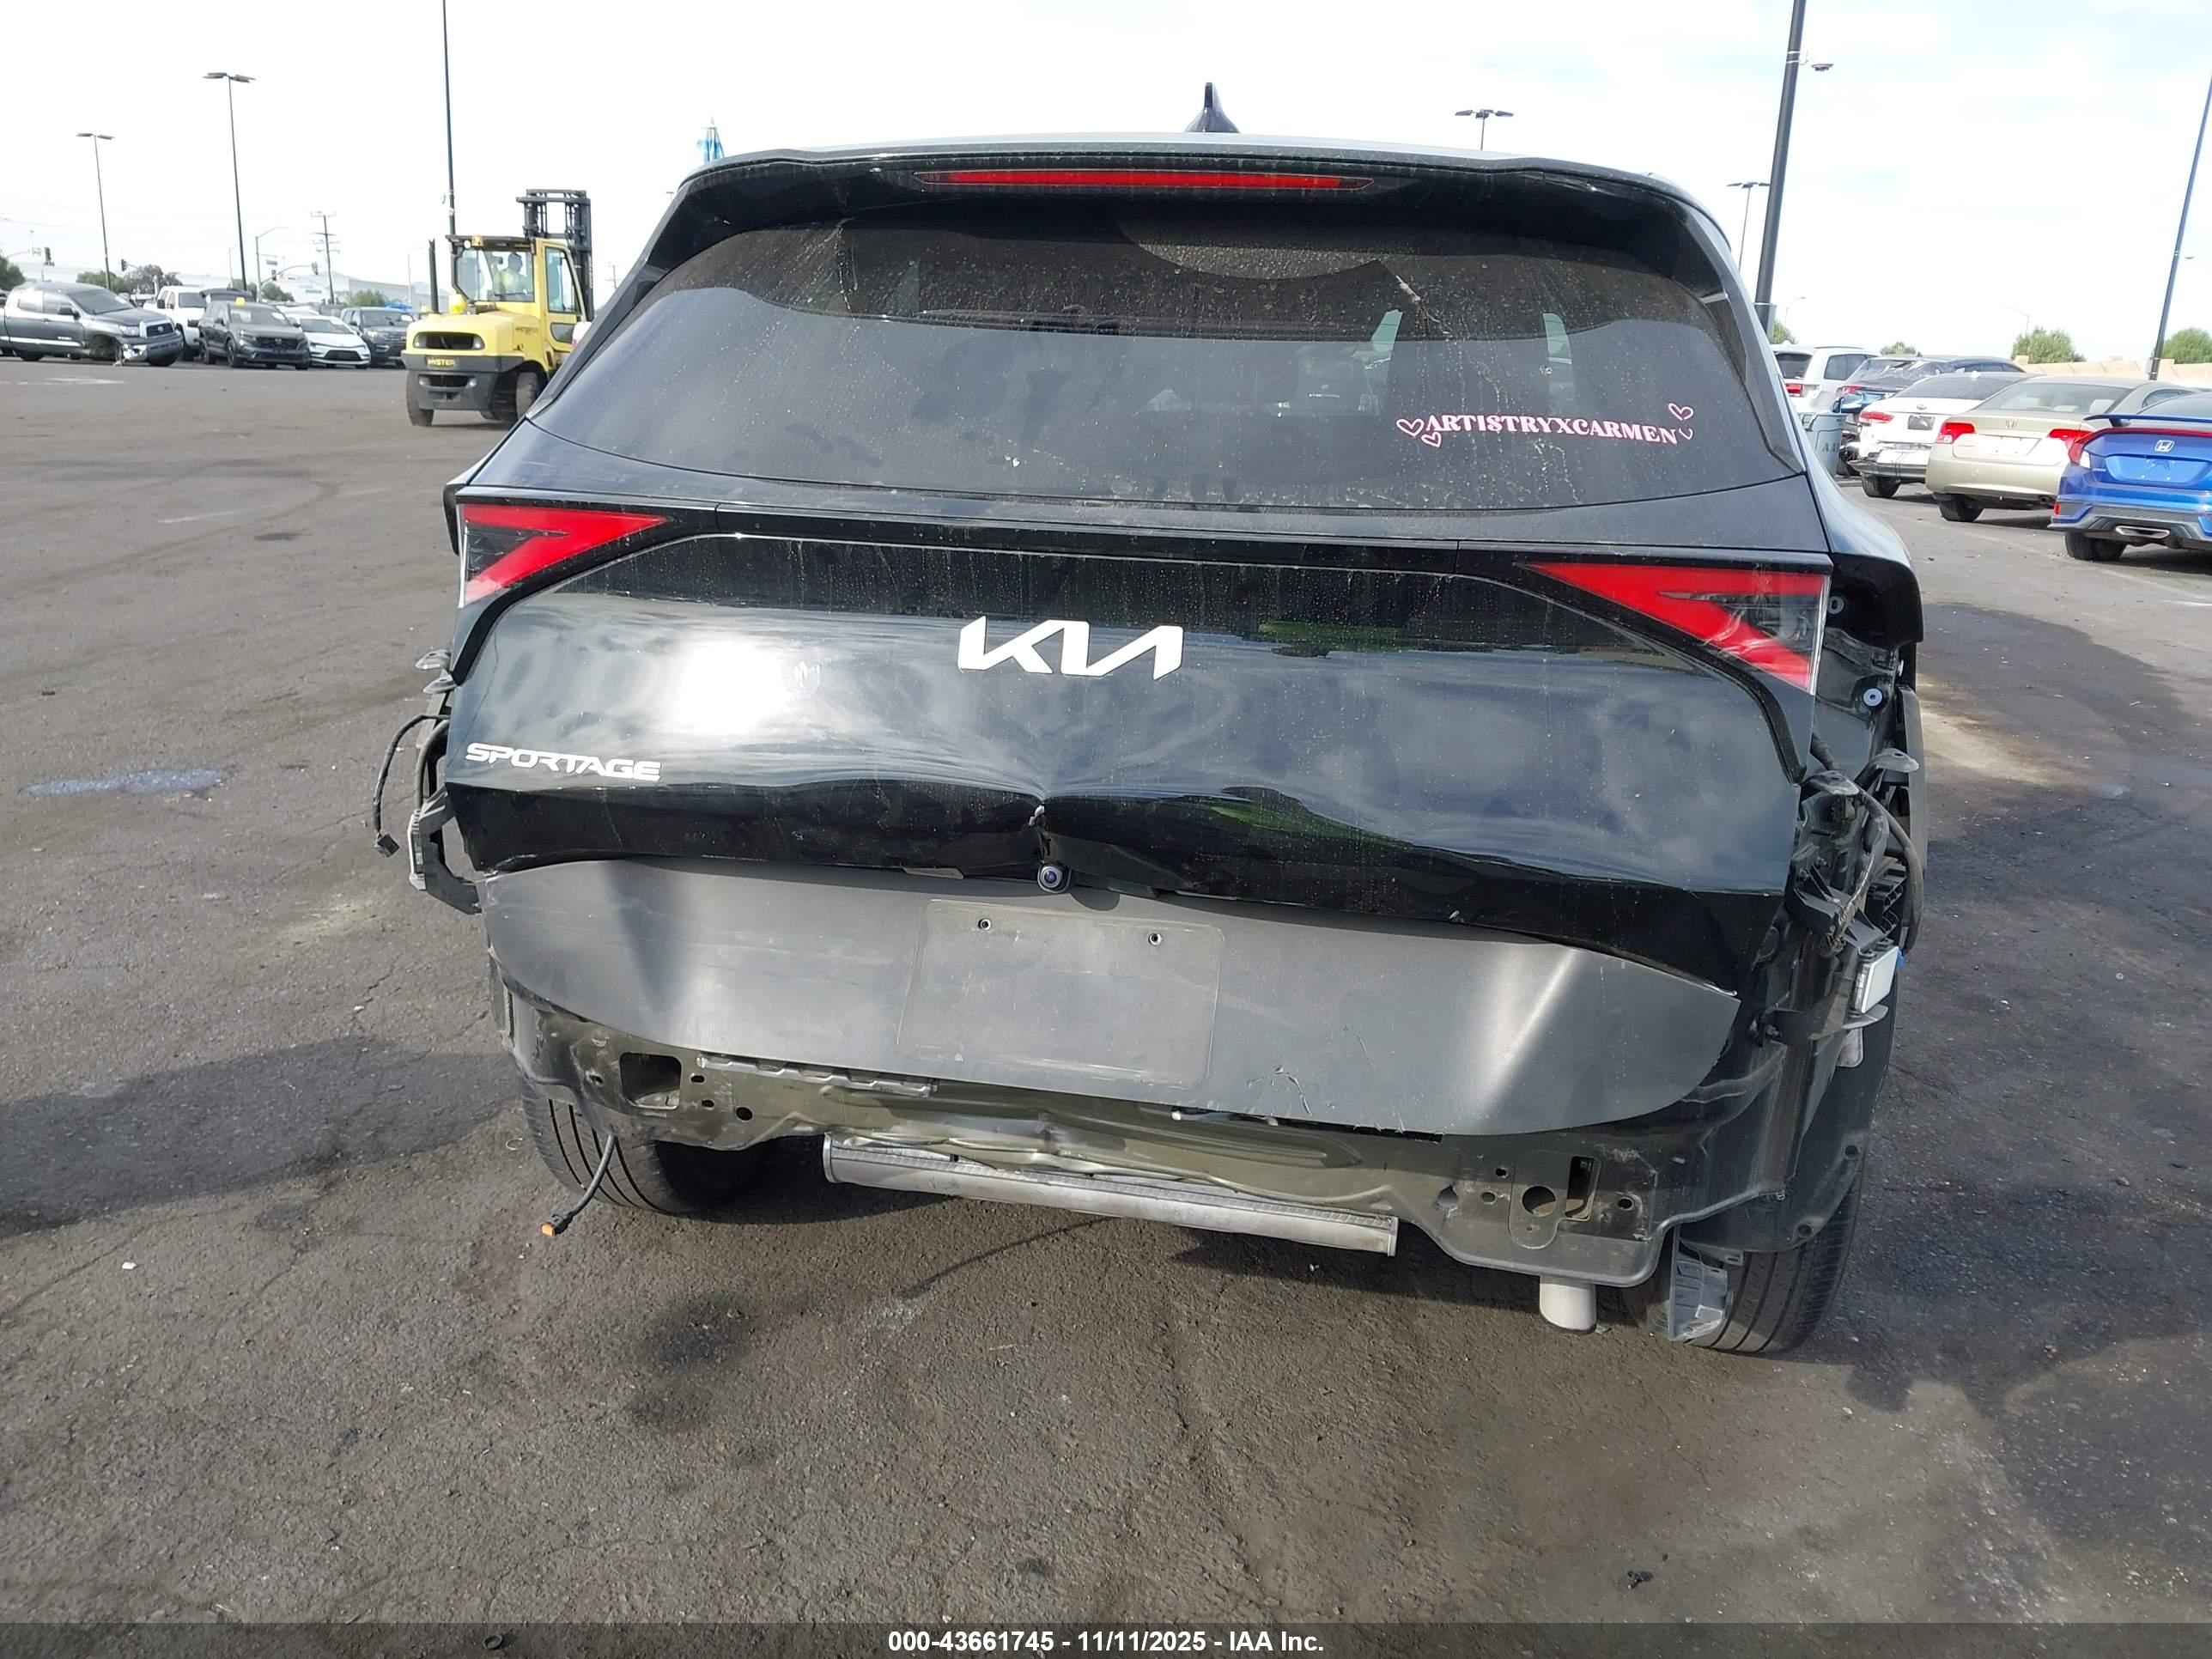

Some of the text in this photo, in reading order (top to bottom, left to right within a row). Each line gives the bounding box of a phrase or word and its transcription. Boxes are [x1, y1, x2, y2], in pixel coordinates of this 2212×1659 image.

[1425, 414, 1678, 445] ARTISTRYXCARMEN
[957, 616, 1183, 680] KIA
[465, 742, 661, 781] SPORTAGE
